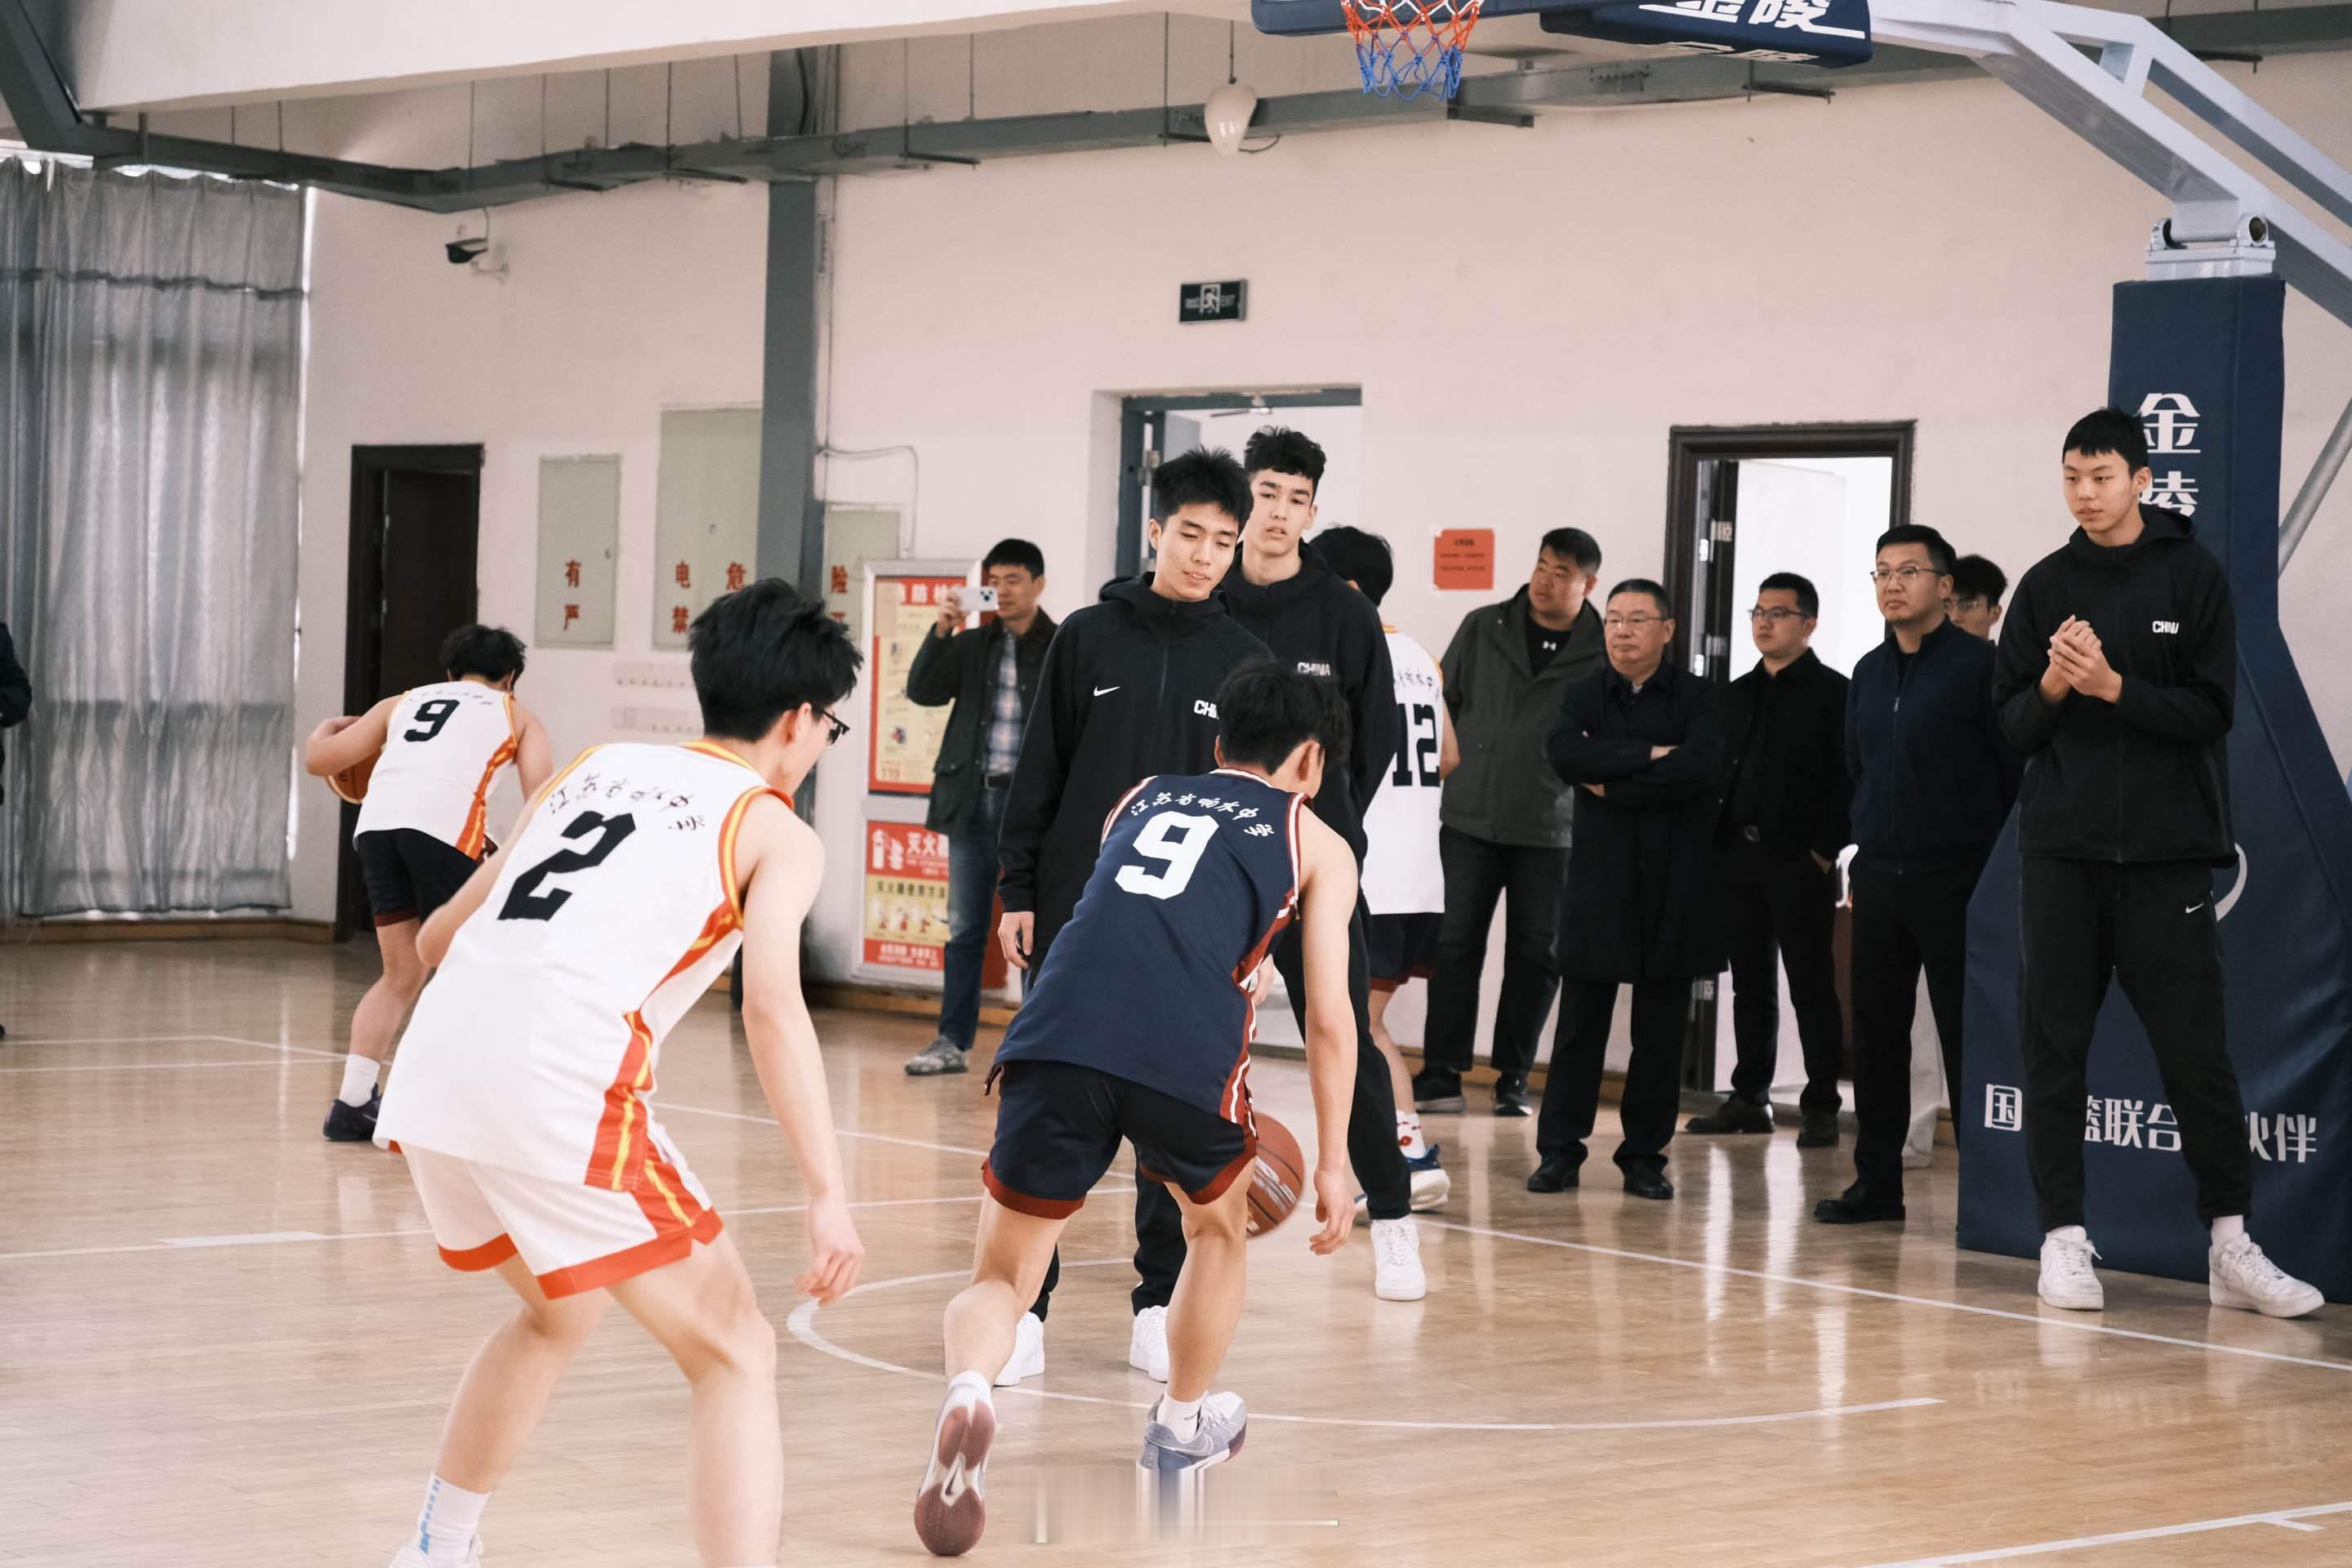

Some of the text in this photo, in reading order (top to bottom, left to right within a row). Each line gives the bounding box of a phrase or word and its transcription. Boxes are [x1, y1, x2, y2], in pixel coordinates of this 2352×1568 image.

[565, 559, 581, 588] 有
[675, 559, 691, 589] 电
[726, 562, 746, 590] 危
[564, 604, 689, 634] 严 禁
[403, 699, 460, 742] 9
[1392, 703, 1441, 787] 12
[497, 810, 636, 921] 2
[1115, 810, 1219, 900] 9
